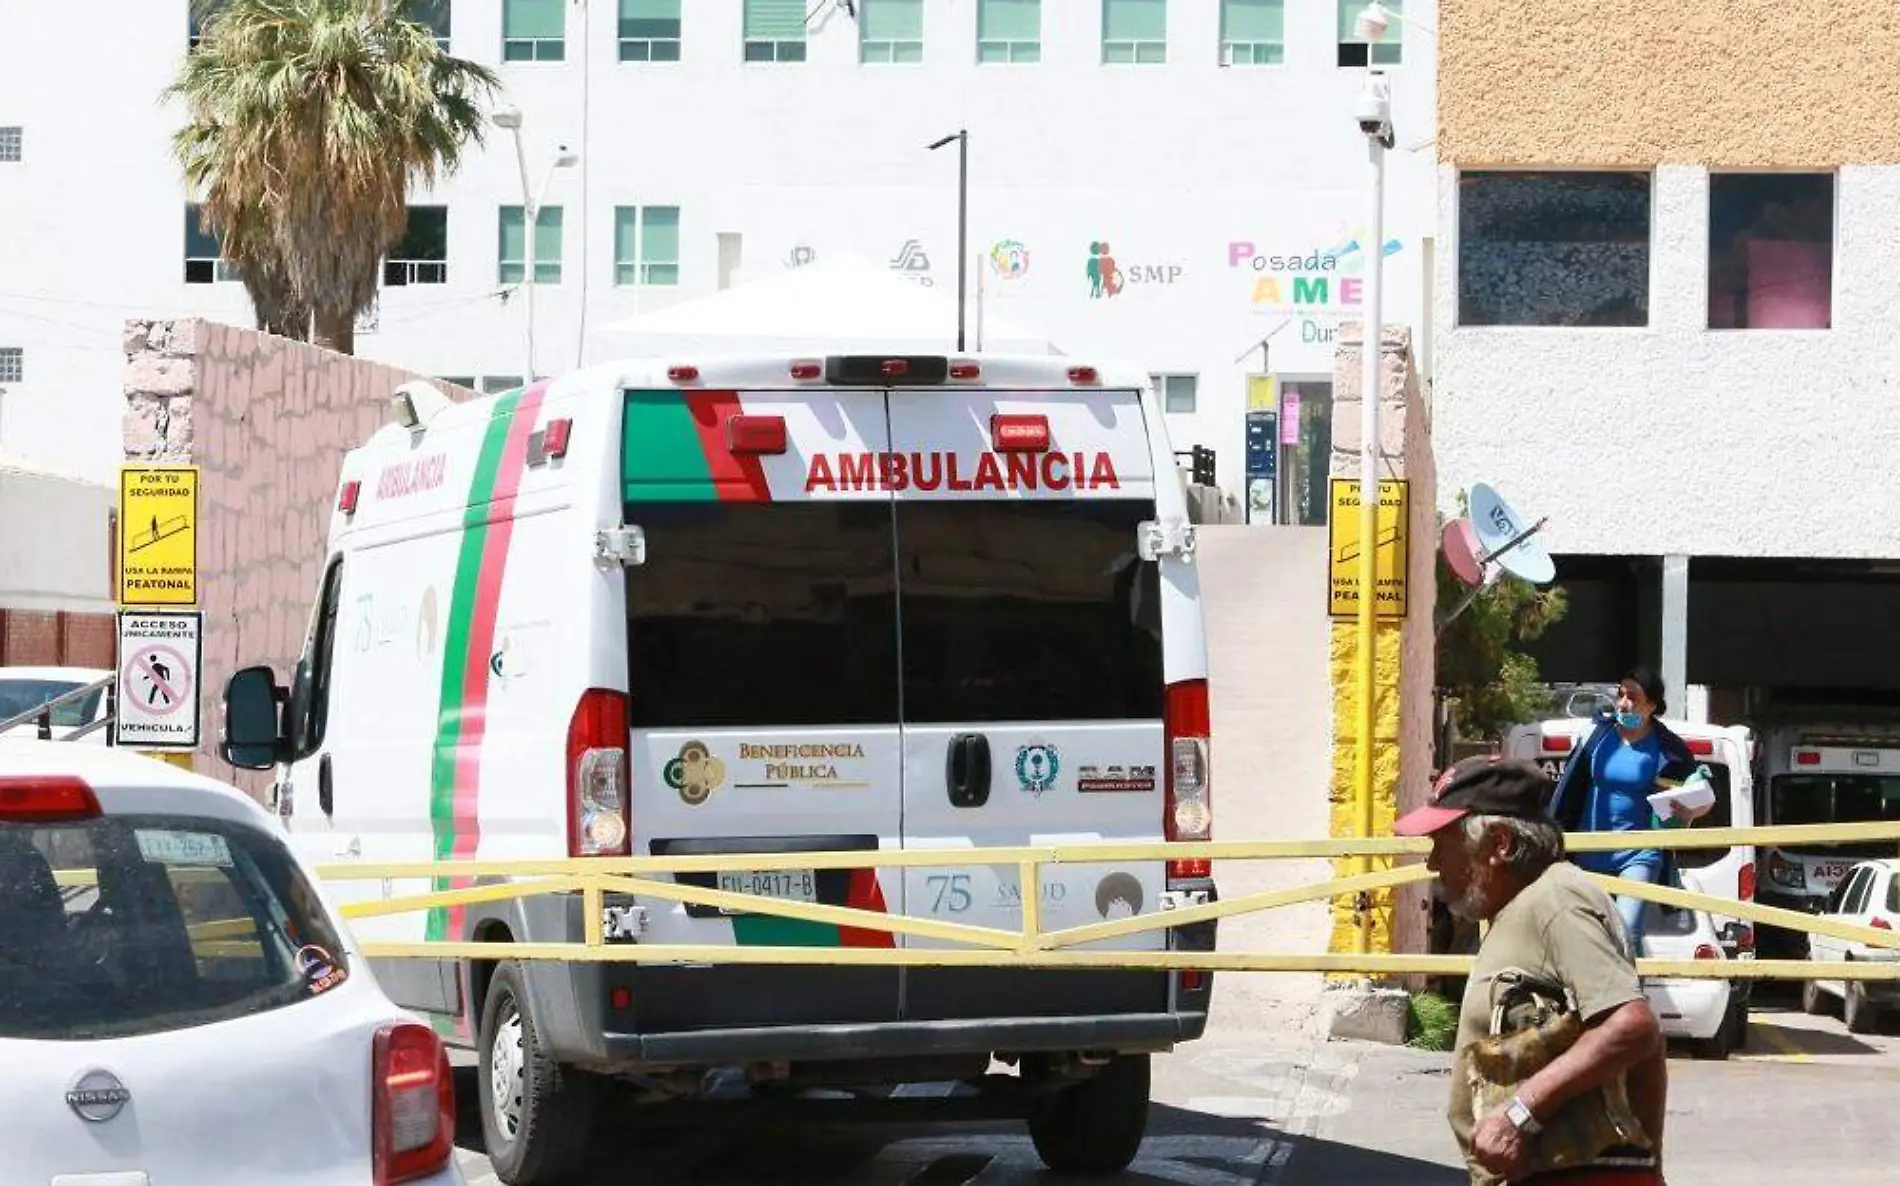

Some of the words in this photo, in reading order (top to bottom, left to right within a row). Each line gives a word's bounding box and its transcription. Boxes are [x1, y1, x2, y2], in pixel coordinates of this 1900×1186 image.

[1228, 241, 1338, 272] Posada
[1128, 265, 1183, 284] SMP
[1253, 276, 1364, 305] AME
[1302, 319, 1339, 343] Dur
[804, 451, 1121, 492] AMBULANCIA
[140, 474, 162, 484] POR
[166, 474, 179, 484] TU
[129, 488, 191, 497] SEGURIDAD
[1338, 497, 1402, 506] SEGDAD
[146, 567, 159, 575] LA
[126, 579, 191, 590] PEATONAL
[1376, 579, 1403, 587] AMPA
[1334, 590, 1403, 601] PEANAL
[130, 620, 188, 629] ACCESO
[739, 743, 866, 759] BENEFICENCIA
[765, 762, 838, 779] PÚBLICA
[927, 874, 972, 912] 75
